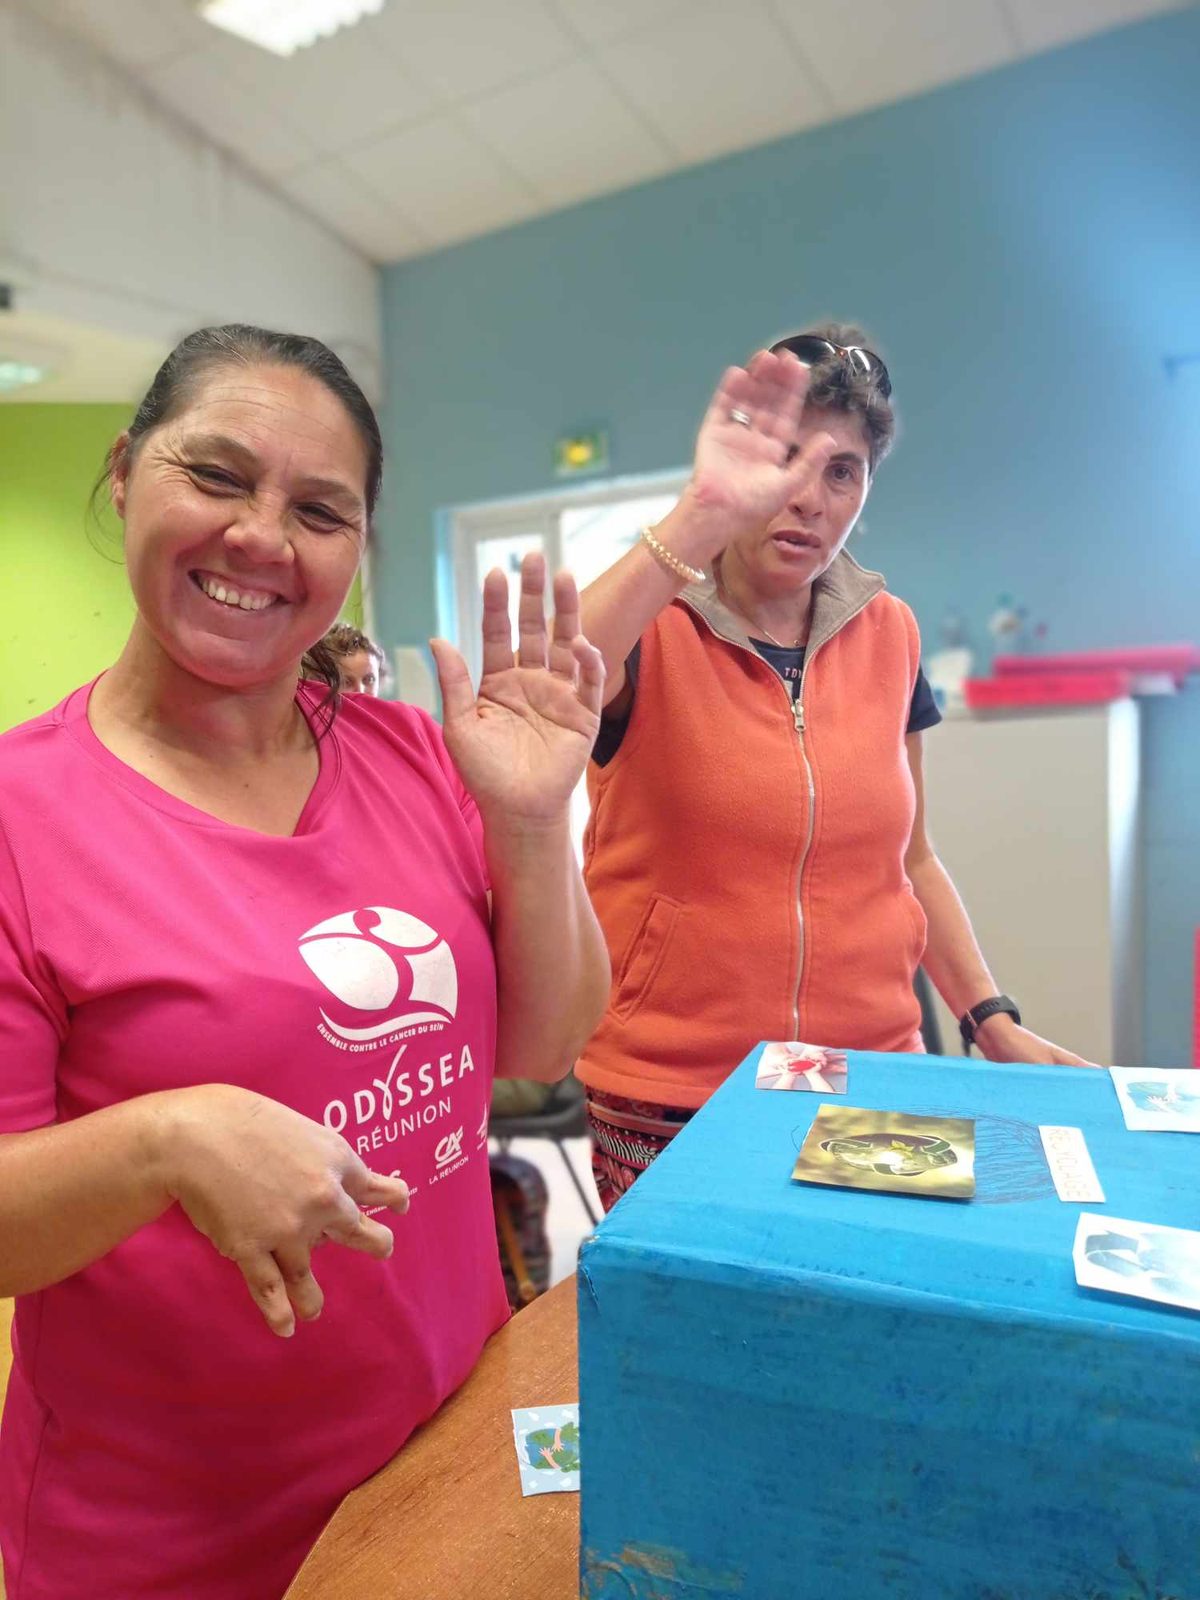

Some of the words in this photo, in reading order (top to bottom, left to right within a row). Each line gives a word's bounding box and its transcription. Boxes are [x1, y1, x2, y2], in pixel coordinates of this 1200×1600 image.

[316, 1023, 348, 1051] ENSEMBLE
[349, 1042, 378, 1053] CONTRE
[379, 1038, 387, 1048] LE
[389, 1027, 416, 1044] CANCER
[418, 1025, 428, 1034] DU
[429, 1023, 444, 1033] SEIN
[323, 1044, 475, 1134] ODYSSEA
[356, 1096, 452, 1156] RÉUNION
[428, 1175, 439, 1185] LA
[439, 1155, 470, 1180] RÉUNION
